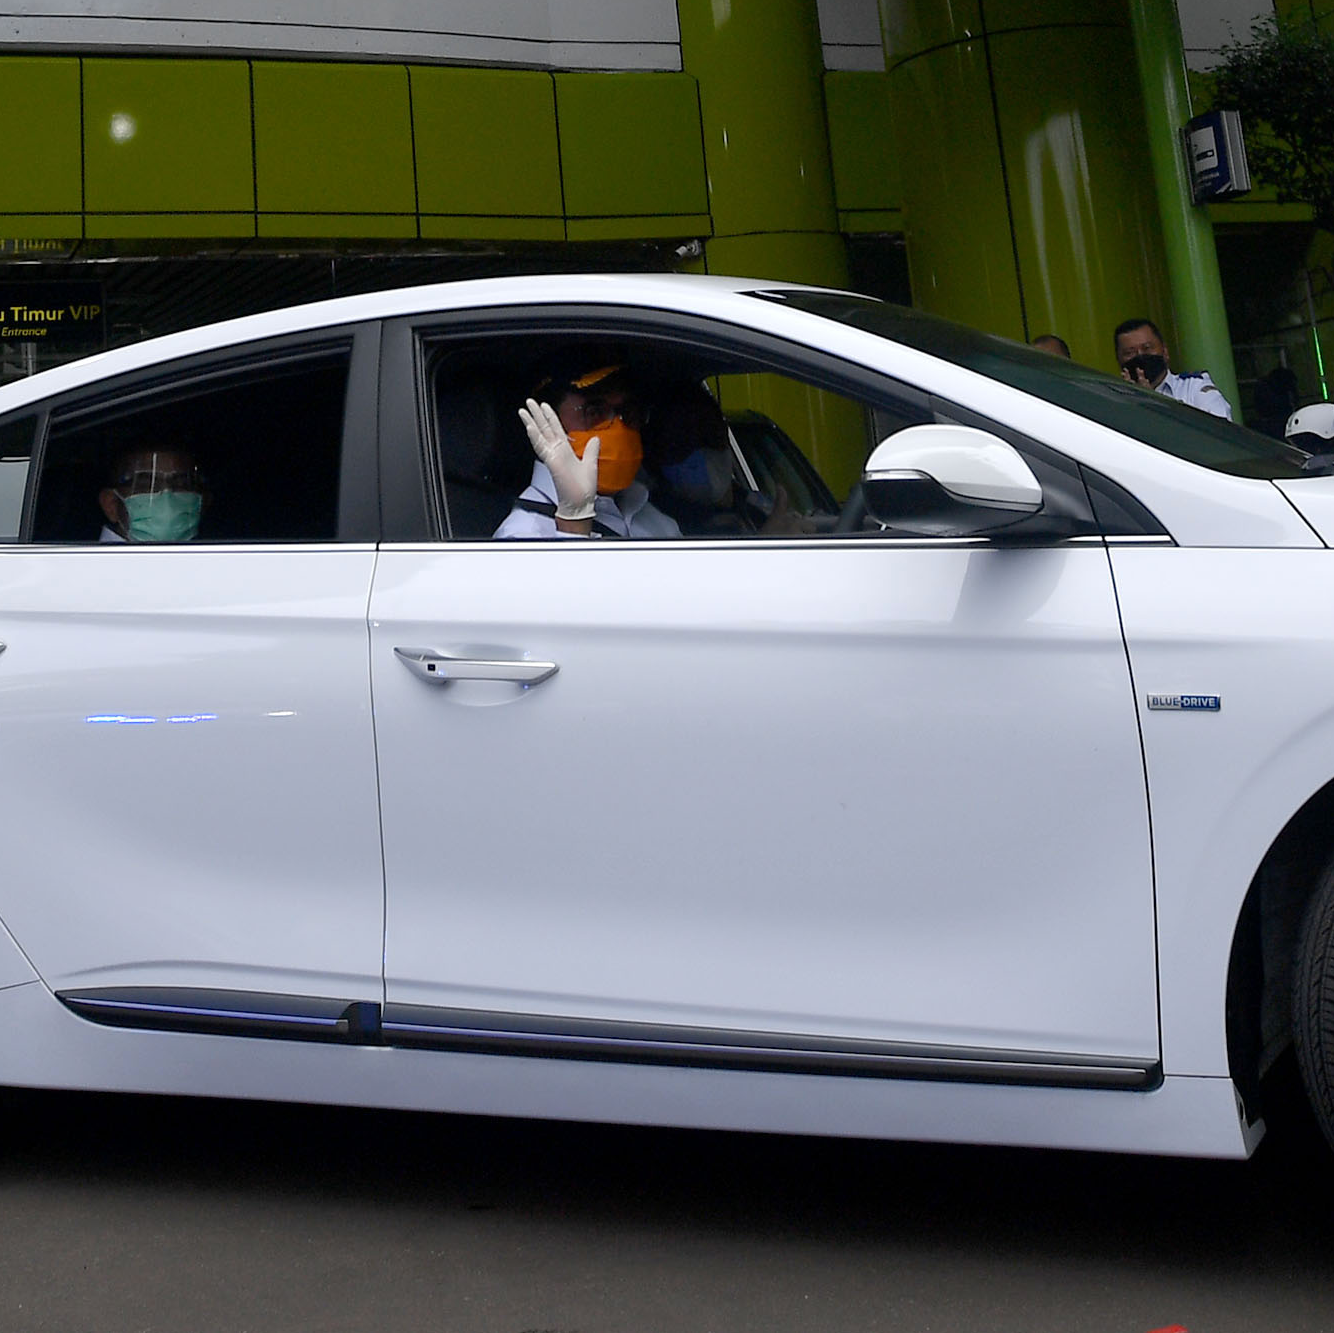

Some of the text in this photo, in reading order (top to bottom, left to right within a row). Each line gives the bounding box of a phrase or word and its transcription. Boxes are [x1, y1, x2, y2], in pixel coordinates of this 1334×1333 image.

[10, 306, 65, 321] Timur
[69, 305, 101, 320] VIP
[1, 327, 47, 337] Entrance
